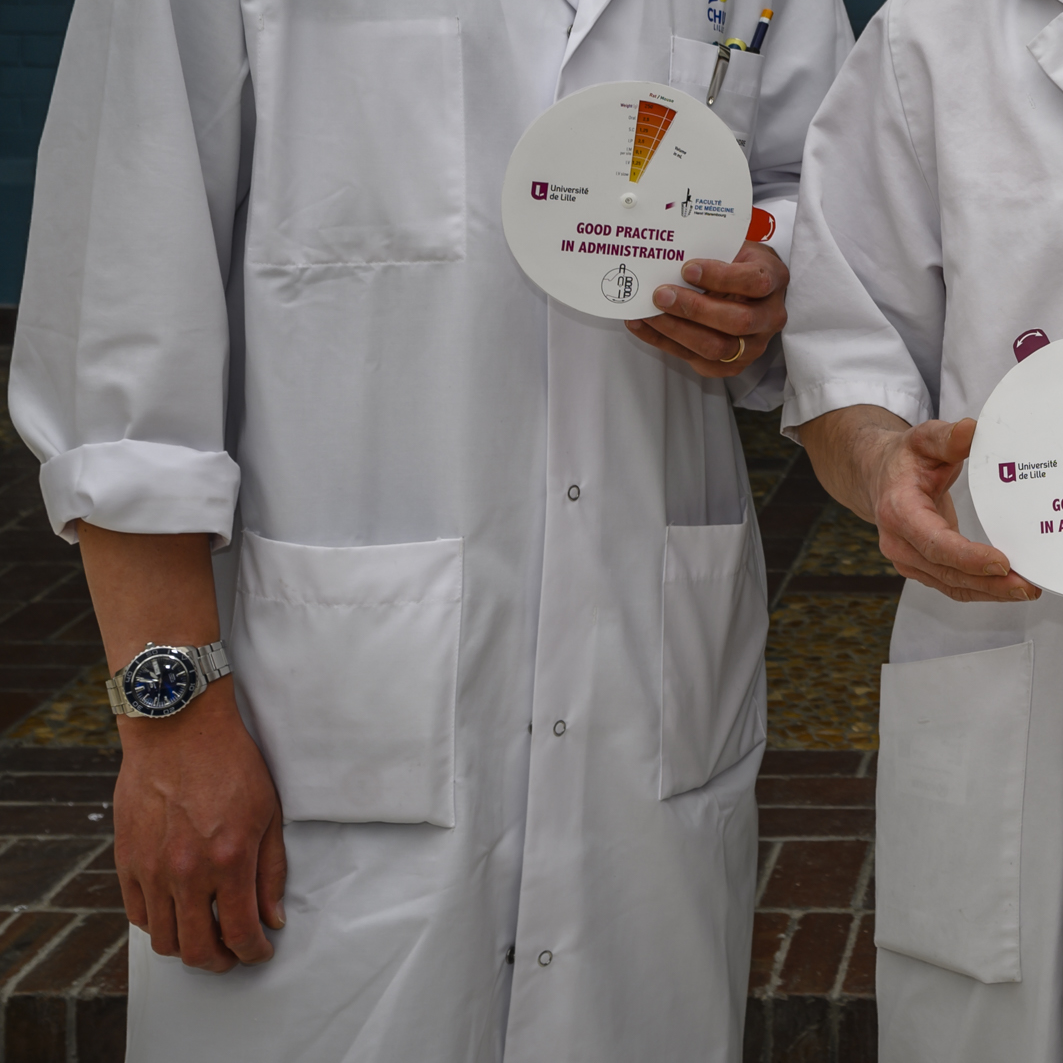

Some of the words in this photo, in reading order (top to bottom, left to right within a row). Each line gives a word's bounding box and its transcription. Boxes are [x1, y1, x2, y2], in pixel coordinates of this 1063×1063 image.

[550, 184, 589, 195] Université
[549, 193, 559, 201] de
[560, 193, 577, 202] Lille
[695, 198, 722, 206] FACULTÉ
[704, 205, 735, 213] MÉDECINE
[576, 222, 612, 236] GOOD
[616, 225, 675, 242] PRACTICE
[561, 239, 575, 252] IN
[578, 241, 685, 261] ADMINISTRATION
[1017, 459, 1058, 471] Université
[1018, 472, 1028, 480] de
[1029, 470, 1046, 479] Lille
[1040, 520, 1054, 534] IN
